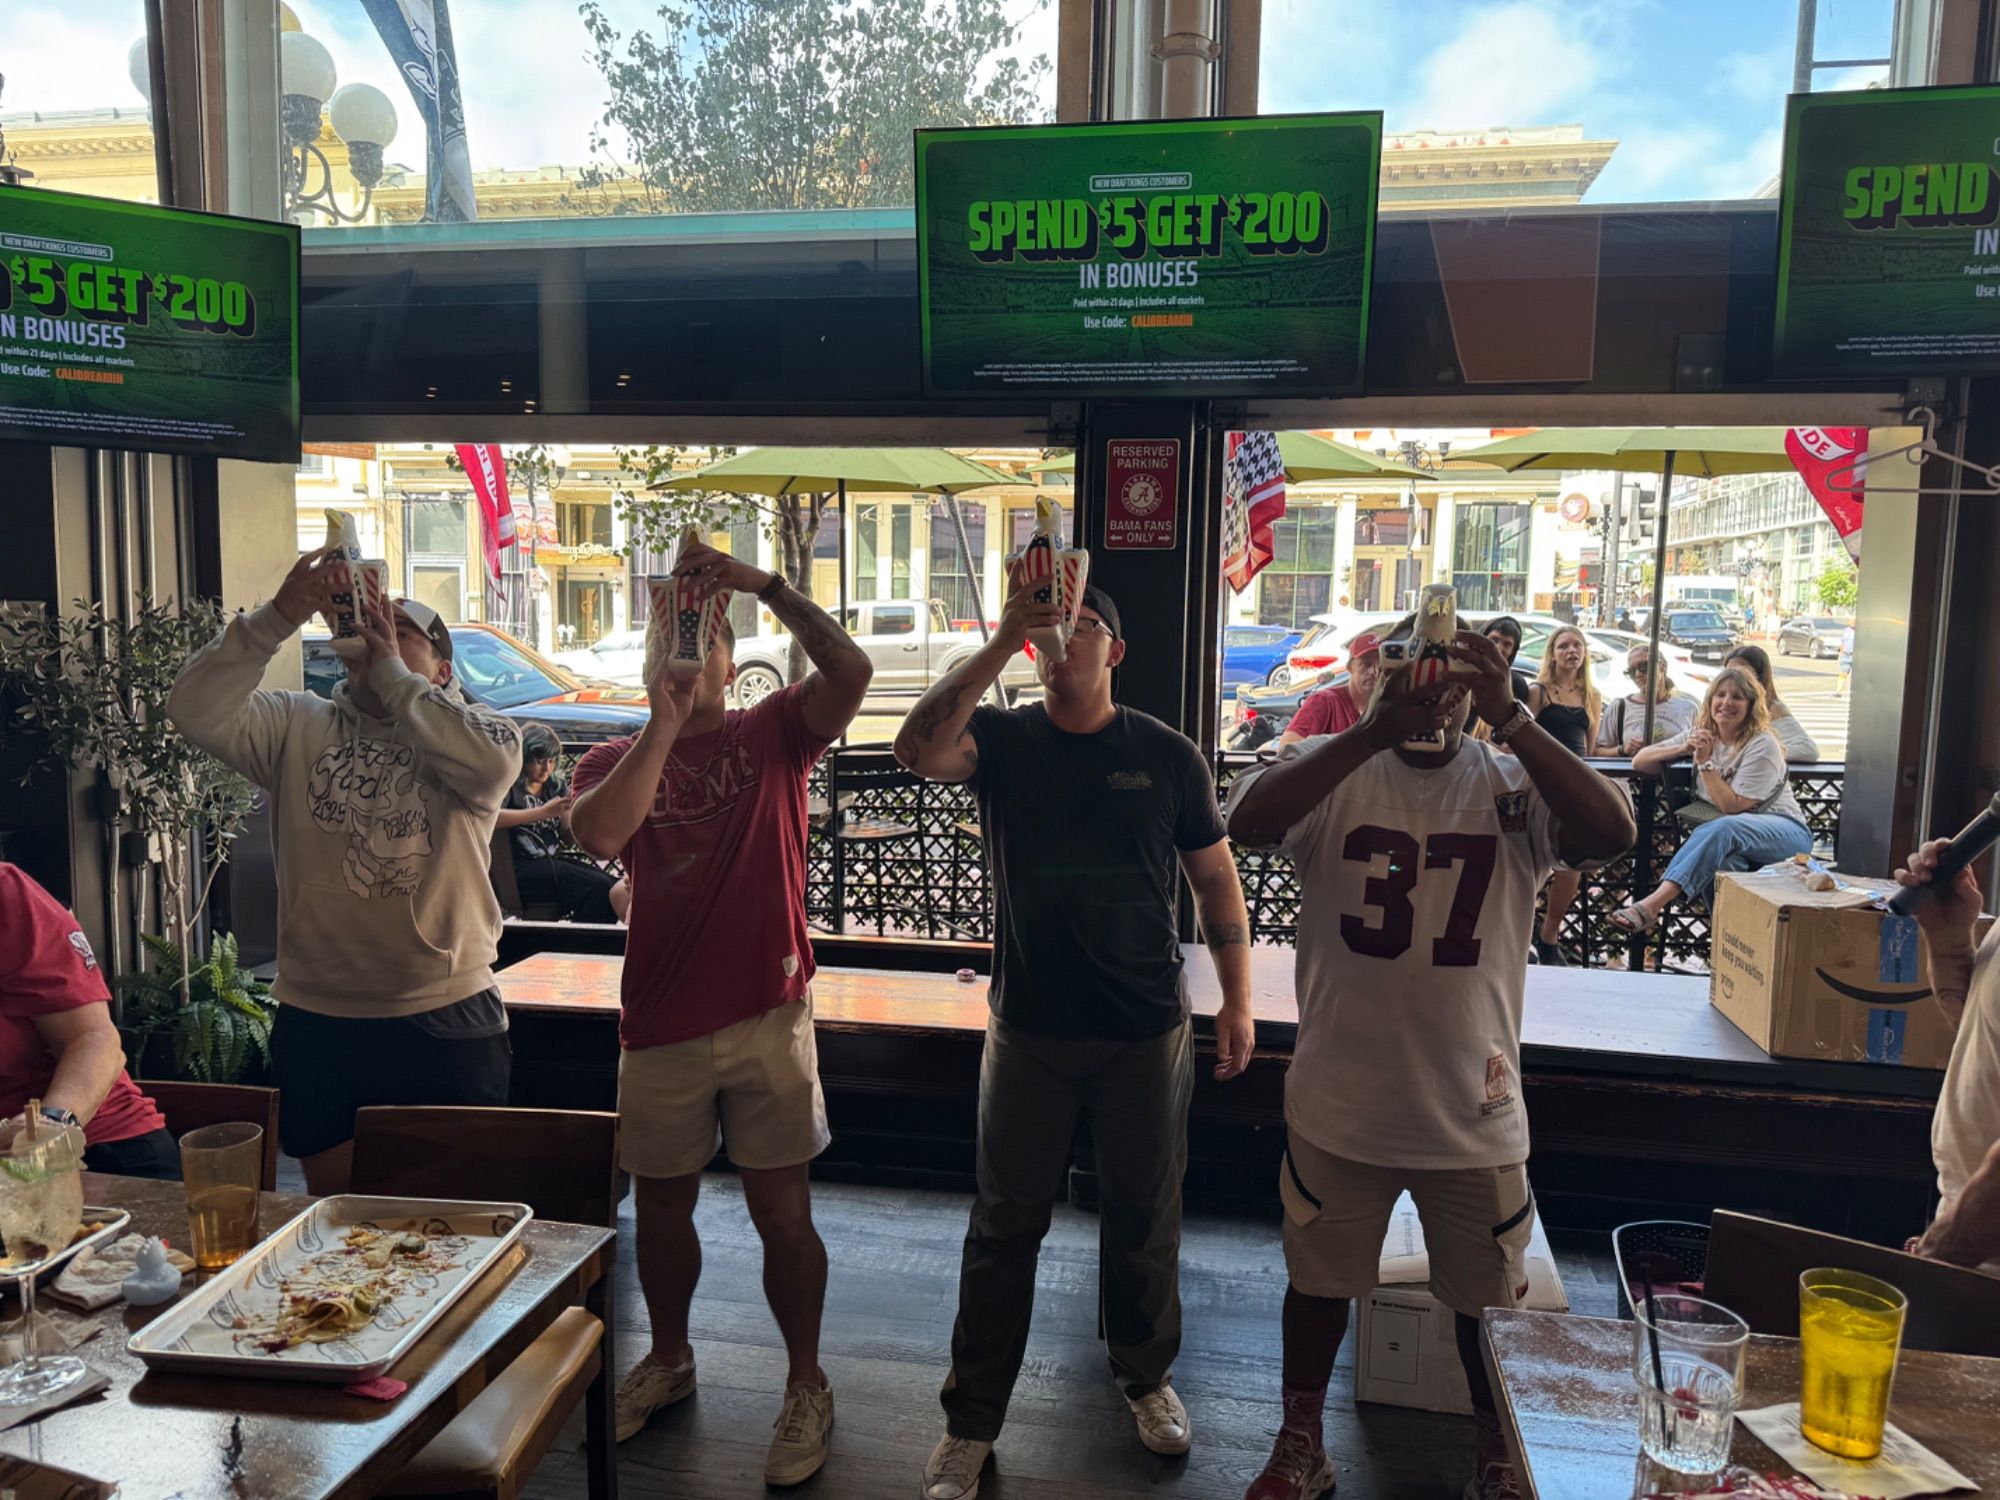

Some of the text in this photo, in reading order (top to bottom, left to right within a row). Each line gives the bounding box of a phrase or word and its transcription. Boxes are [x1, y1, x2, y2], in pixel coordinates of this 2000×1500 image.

[1150, 176, 1187, 185] CUSTOMERS
[1843, 162, 1990, 219] SPEND
[968, 191, 1321, 251] SPEND $5 GET $200
[4, 236, 108, 257] NEW DRAFTKINGS CUSTOMERS
[1974, 229, 1999, 255] IN
[1080, 260, 1198, 289] IN BONUSES
[11, 256, 247, 326] $5 GET $200
[1976, 284, 1996, 297] Use
[1073, 298, 1088, 307] Paid
[1119, 297, 1134, 308] days
[1168, 295, 1177, 304] all
[1178, 295, 1205, 305] markets
[0, 314, 126, 349] N BONUSES
[1084, 316, 1100, 328] Use
[1102, 315, 1127, 328] Code:
[4, 346, 29, 356] within
[30, 348, 39, 357] 21
[40, 350, 57, 360] days
[95, 355, 104, 364] all
[105, 357, 135, 366] markets
[1, 363, 20, 374] Use
[22, 364, 50, 377] Code:
[1113, 446, 1174, 457] RESERVED
[1799, 428, 1831, 456] DE
[1117, 458, 1169, 469] PARKING
[1110, 521, 1172, 531] BAMA FANS
[1127, 533, 1154, 543] ONLY
[1340, 824, 1497, 967] 37
